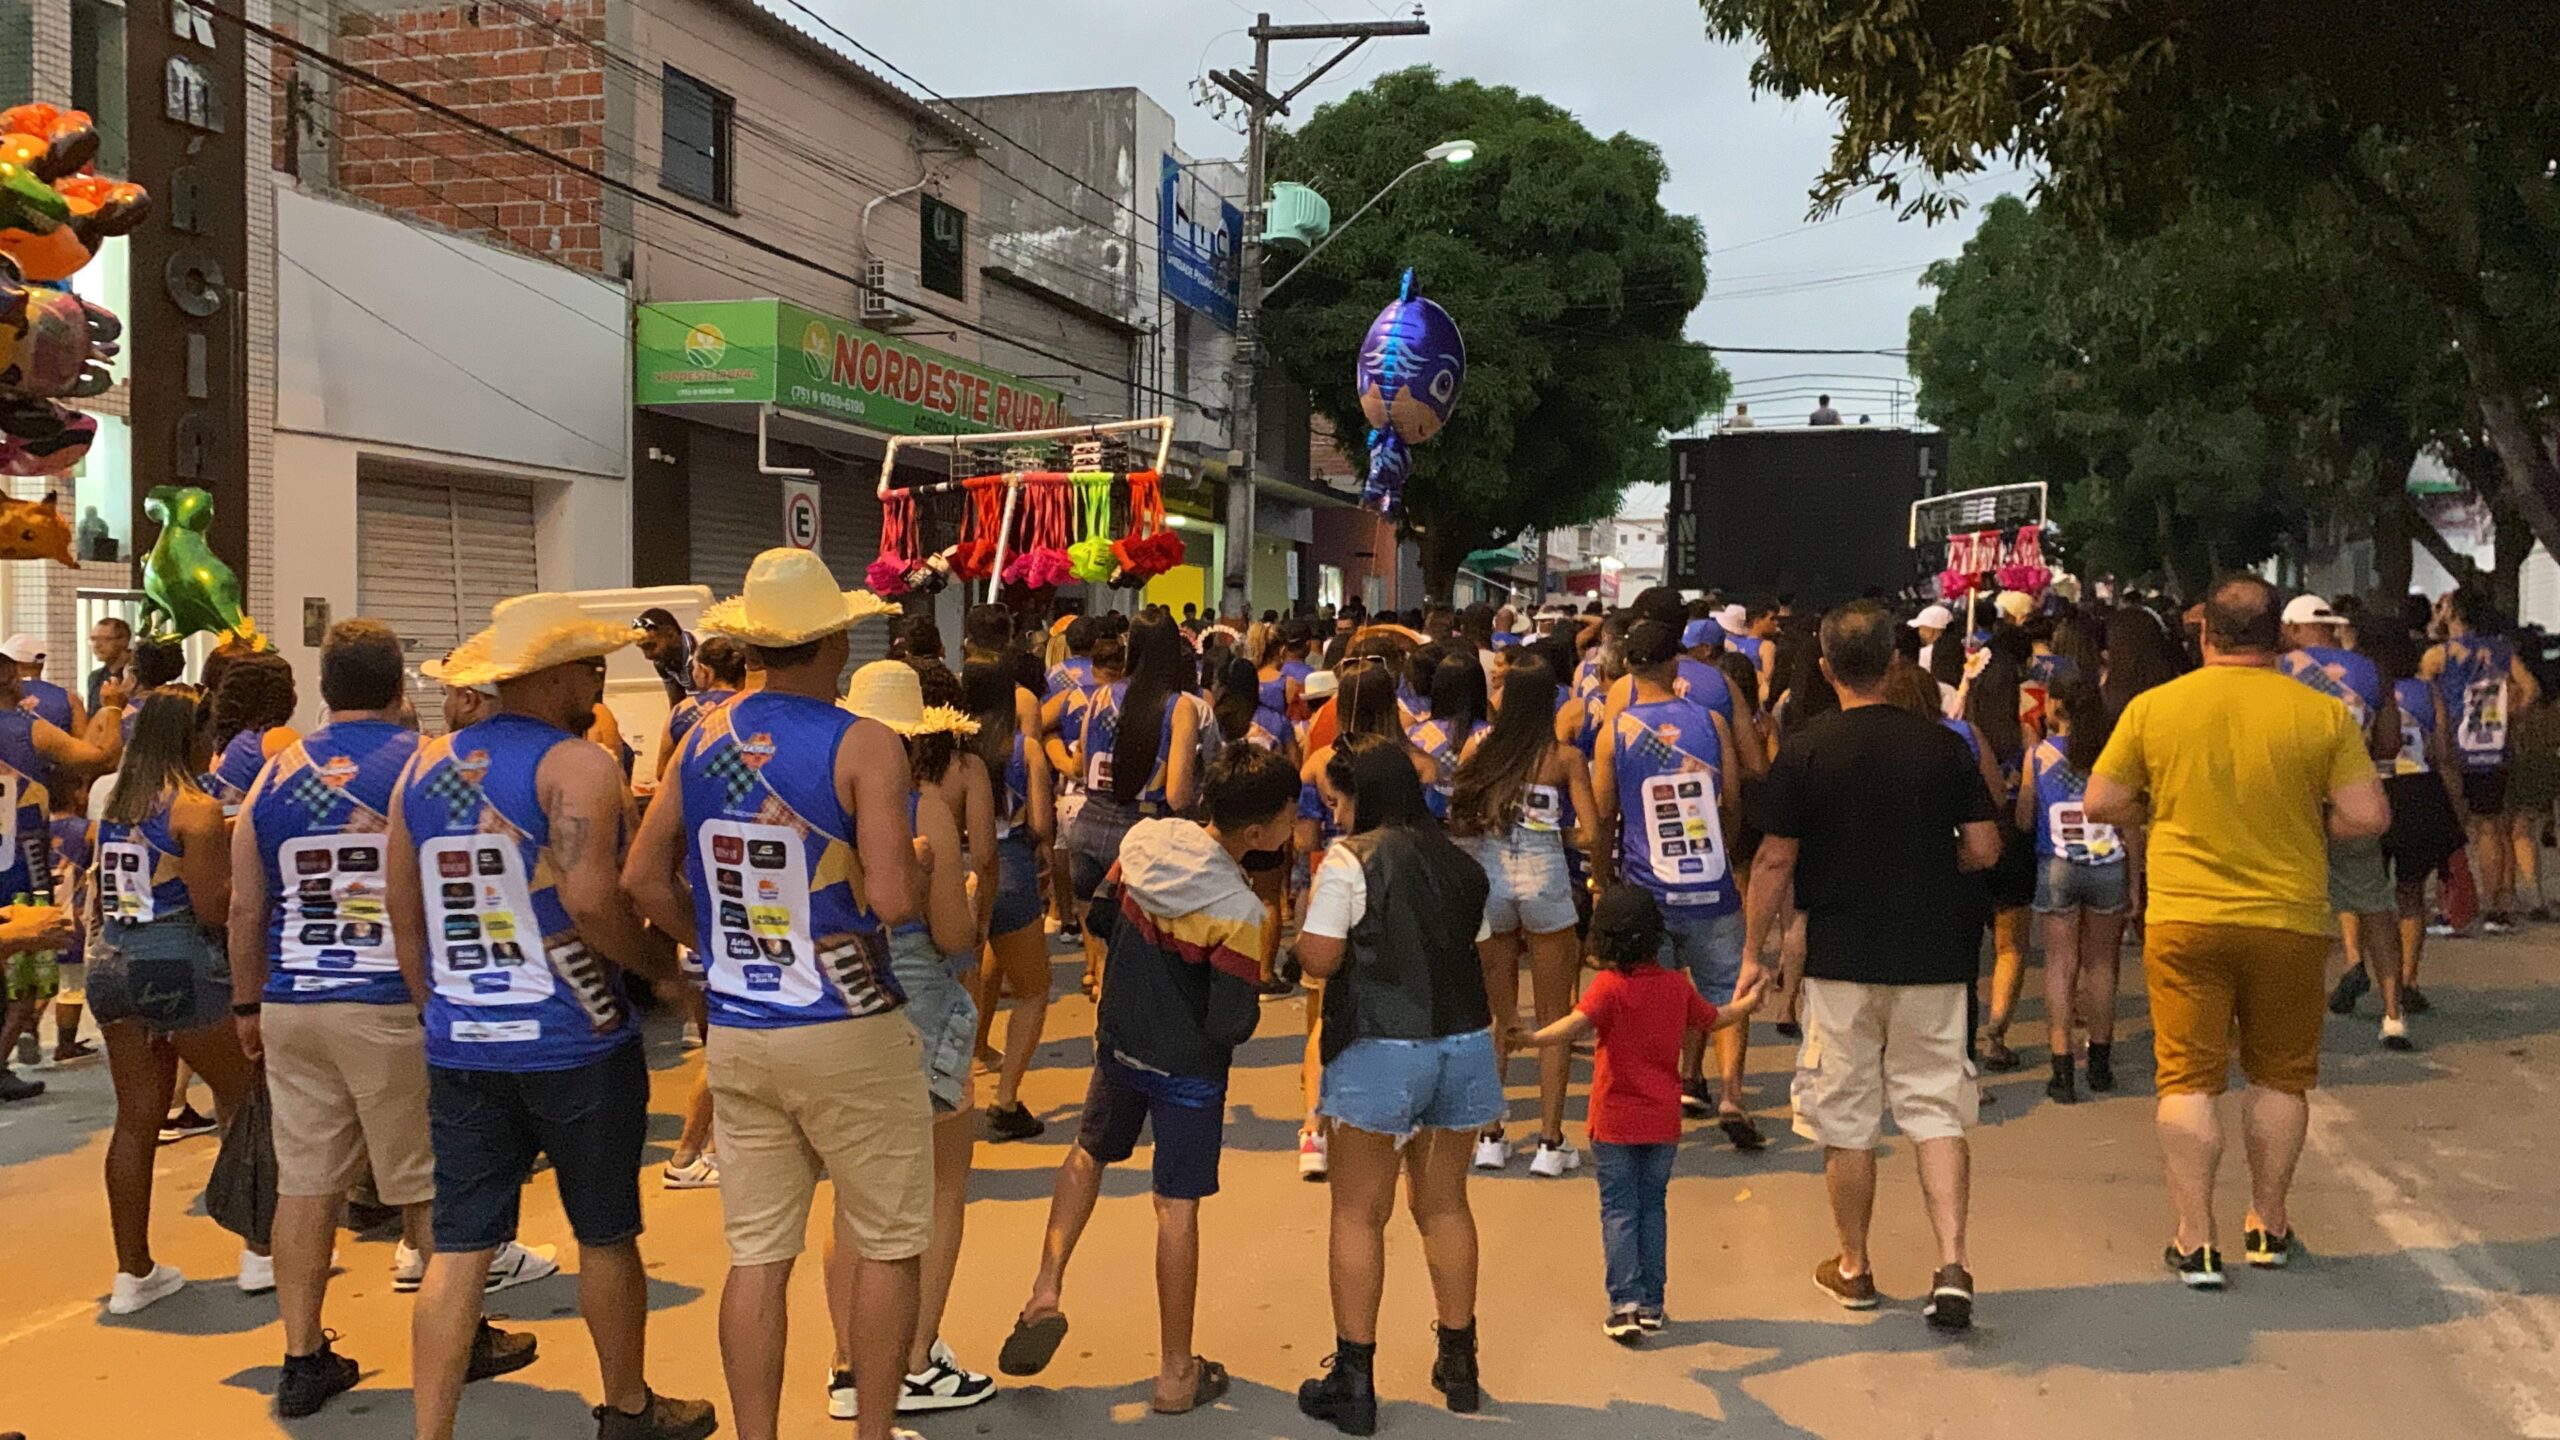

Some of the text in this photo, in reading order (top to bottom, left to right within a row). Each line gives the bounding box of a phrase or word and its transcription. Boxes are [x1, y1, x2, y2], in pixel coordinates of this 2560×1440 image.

[831, 330, 1069, 434] NORDESTE RURAL
[796, 506, 810, 538] E
